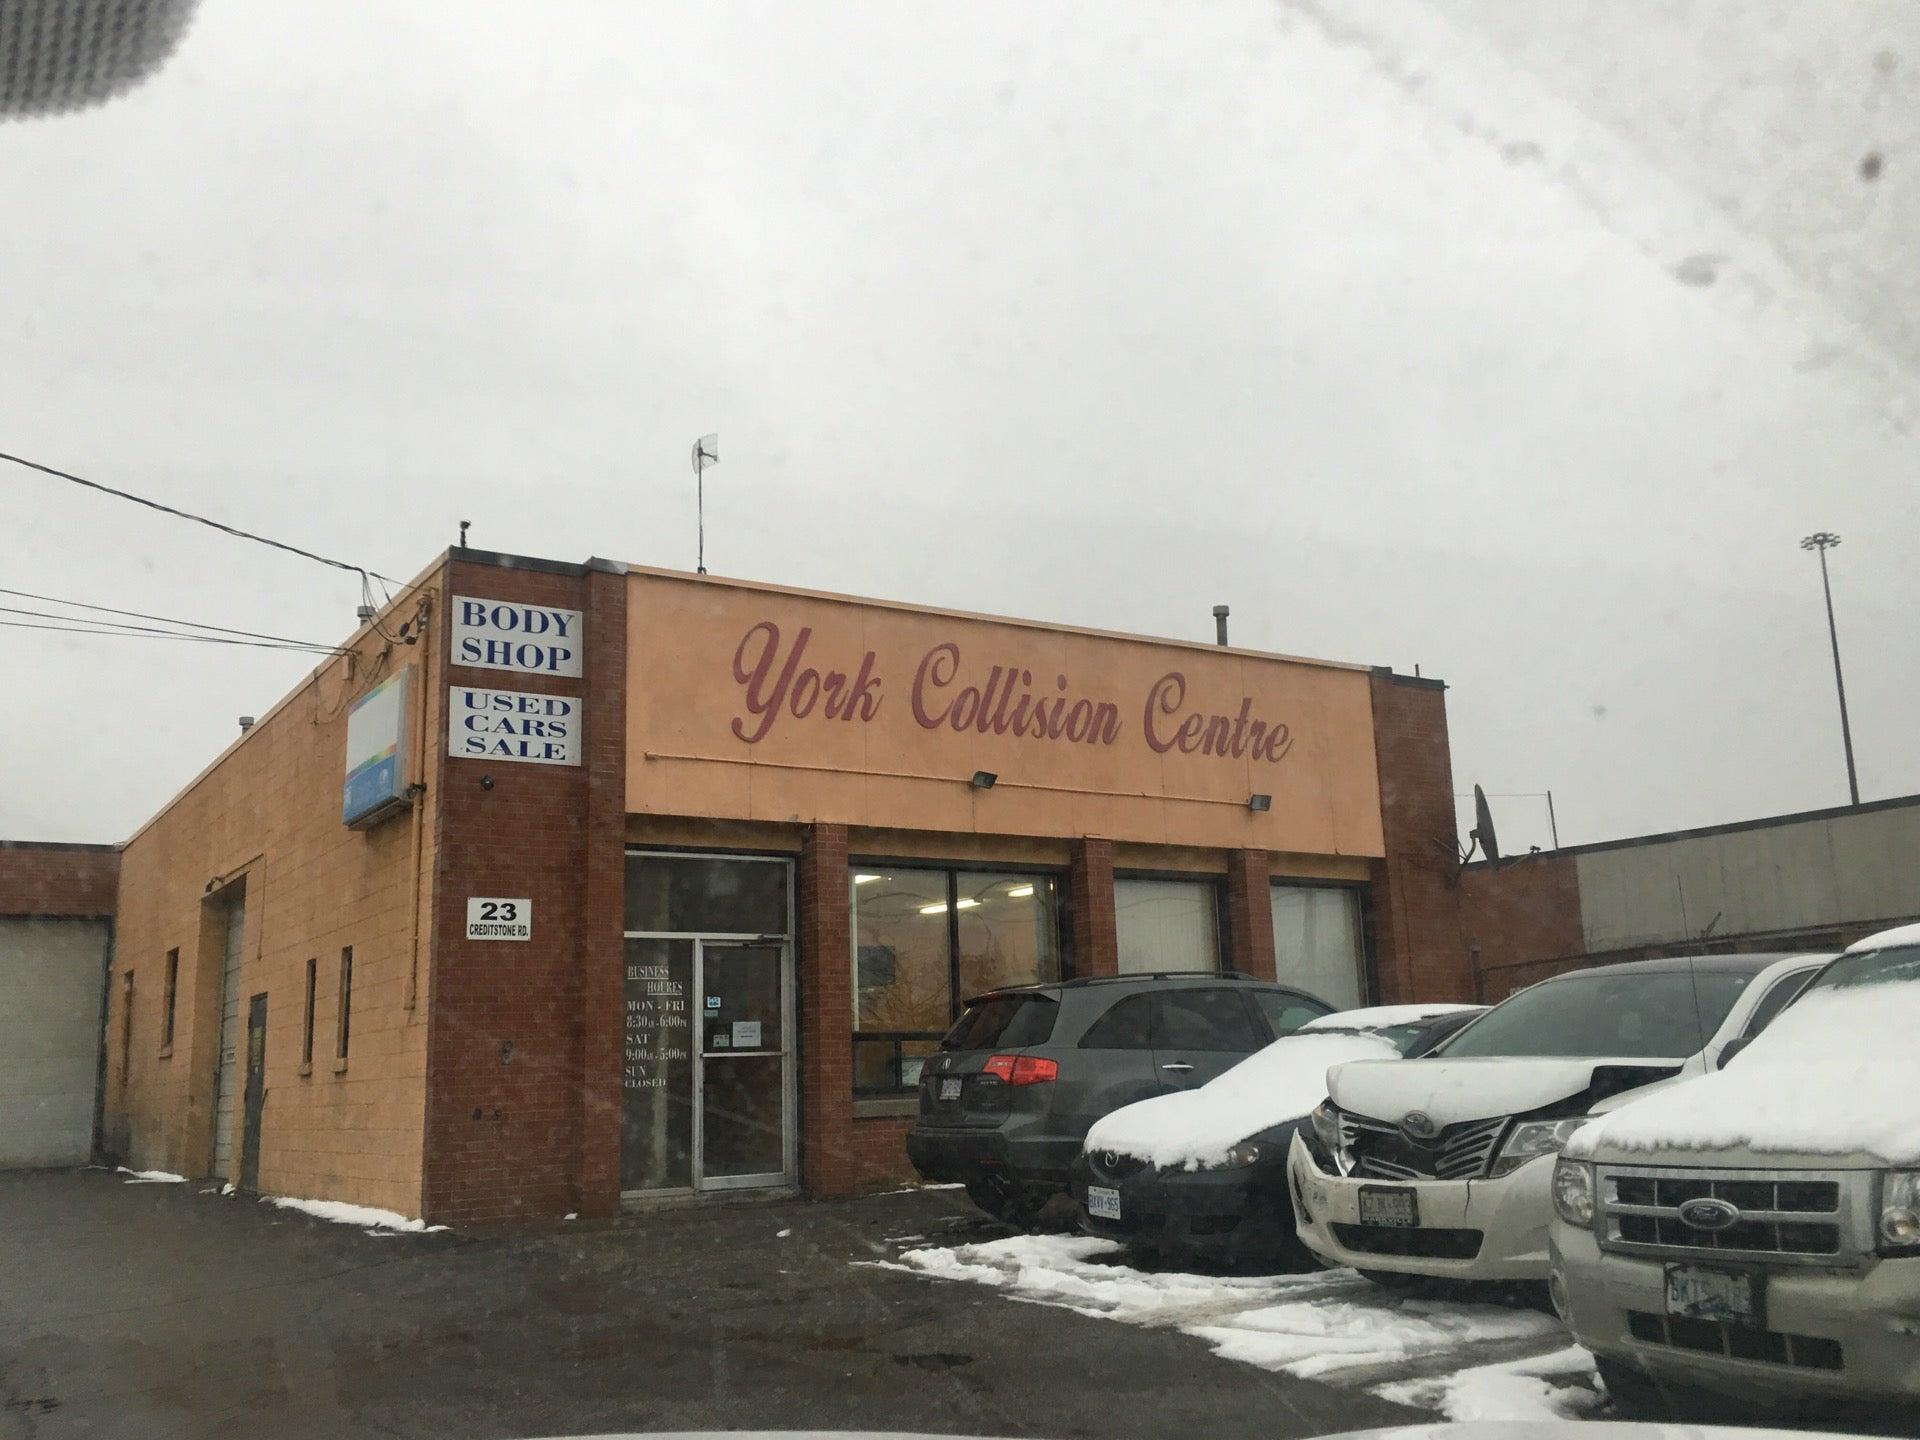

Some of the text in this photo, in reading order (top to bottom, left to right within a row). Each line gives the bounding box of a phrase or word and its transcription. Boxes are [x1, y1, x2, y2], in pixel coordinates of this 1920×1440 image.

[461, 601, 575, 638] BODY
[461, 637, 571, 671] SHOP
[730, 621, 1294, 763] York Collision Centre
[464, 692, 571, 717] USED
[464, 715, 567, 739] CARS
[465, 737, 566, 760] SALE
[480, 902, 517, 921] 23
[469, 923, 529, 936] CREDITSTONE RD.
[627, 965, 669, 978] BUSINESS
[626, 1000, 654, 1011] MON
[665, 1000, 684, 1011] FRI
[626, 1033, 650, 1045] SAT
[625, 1065, 646, 1077] SUN
[624, 1078, 666, 1088] CLOSED
